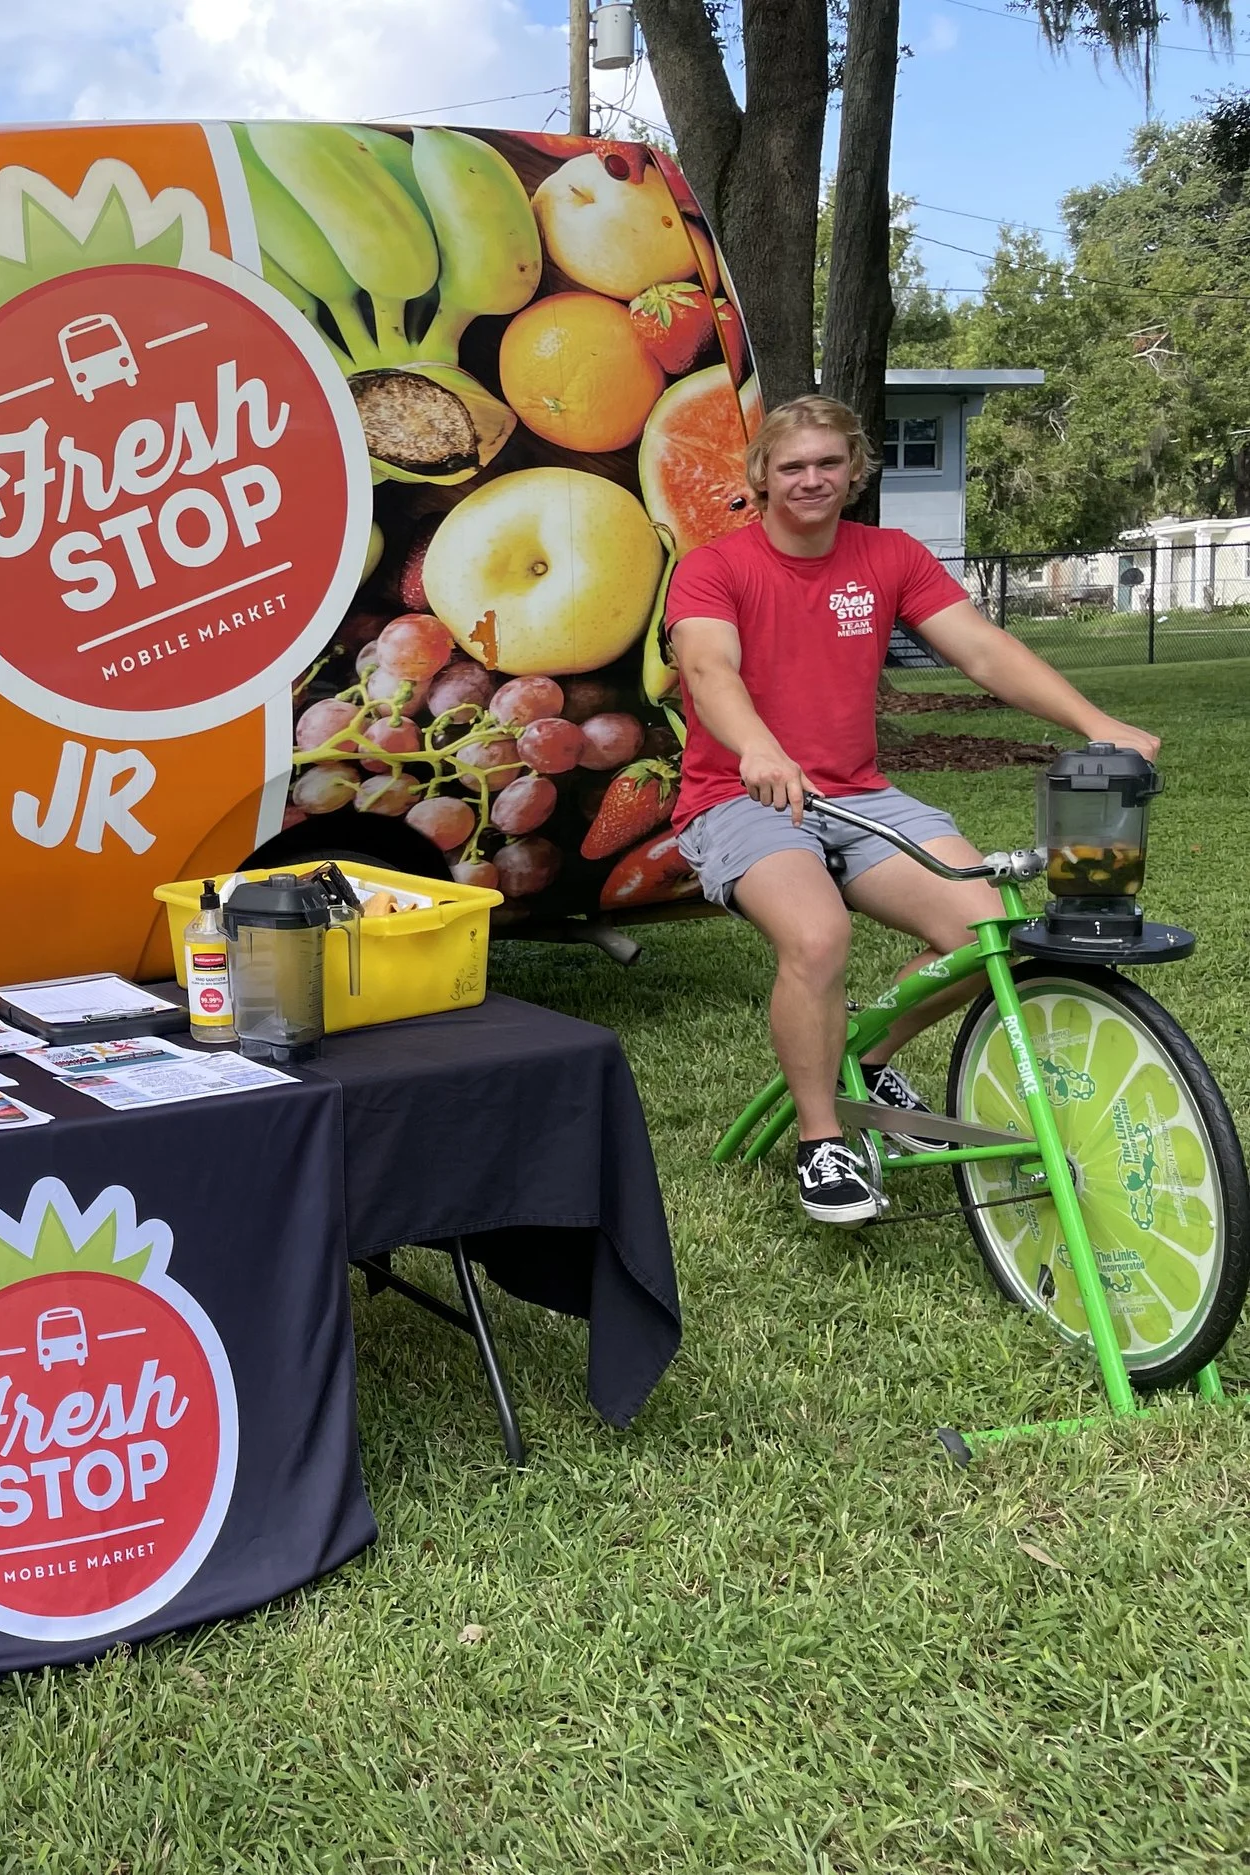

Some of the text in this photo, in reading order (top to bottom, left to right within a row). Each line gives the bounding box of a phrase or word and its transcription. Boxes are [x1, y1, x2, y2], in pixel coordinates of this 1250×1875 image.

[49, 464, 282, 612] STOP
[829, 591, 875, 610] Fresh
[836, 605, 873, 620] STOP
[102, 593, 289, 681] MOBILE MARKET
[837, 627, 873, 637] MEMBER
[840, 621, 870, 630] TEAM
[11, 740, 157, 855] JR
[1003, 1014, 1024, 1049] ROCK
[1017, 1061, 1040, 1097] BIKE
[1112, 1098, 1134, 1165] The Links,
[1120, 1098, 1141, 1164] Incorporated
[1096, 1249, 1141, 1262] The Links,
[1100, 1261, 1145, 1273] Incorporated
[4, 1541, 156, 1583] MOBILE MARKET
